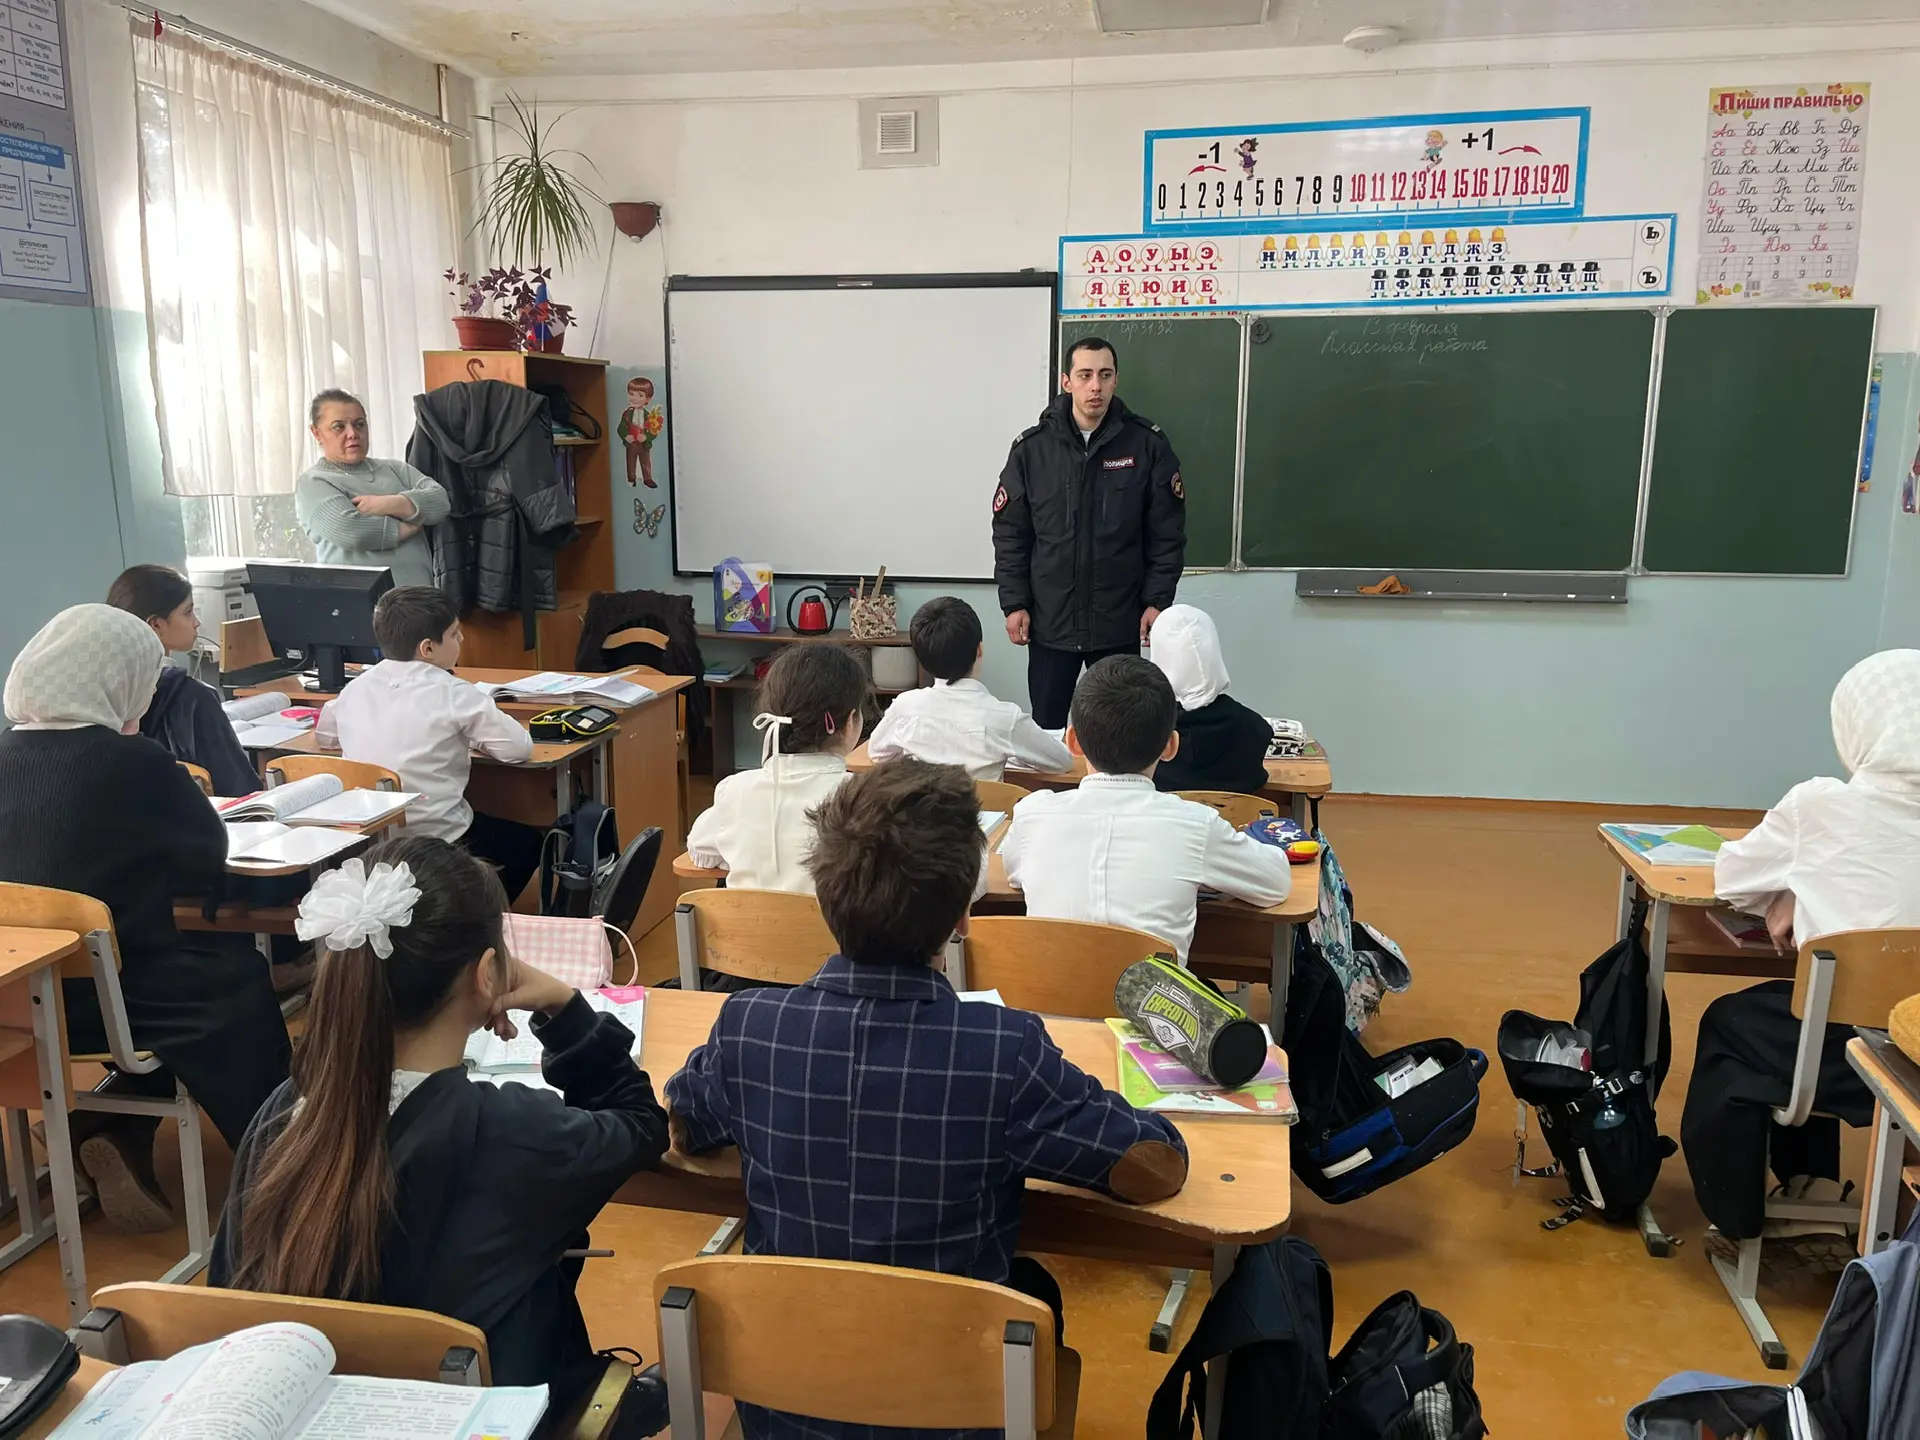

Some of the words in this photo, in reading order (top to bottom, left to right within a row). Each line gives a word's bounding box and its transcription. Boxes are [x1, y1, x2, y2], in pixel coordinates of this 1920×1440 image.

[1462, 128, 1494, 150] +1
[1198, 142, 1220, 164] -1
[1159, 184, 1166, 210] 0
[1180, 183, 1186, 209] 1
[1198, 182, 1206, 208] 2
[1216, 182, 1224, 208] 3
[1234, 181, 1242, 206] 4
[1256, 179, 1264, 206] 5
[1274, 178, 1282, 205] 6
[1296, 176, 1304, 204] 7
[1313, 176, 1322, 204] 8
[1333, 175, 1342, 203] 9
[1350, 174, 1365, 202] 10
[1370, 173, 1385, 201] 11
[1390, 172, 1407, 200] 12
[1410, 171, 1426, 200] 13
[1430, 170, 1446, 198] 14
[1452, 169, 1469, 198] 15
[1472, 168, 1488, 197] 16
[1493, 167, 1510, 196] 17
[1512, 166, 1529, 195] 18
[1531, 165, 1549, 194] 19
[1552, 164, 1569, 193] 20
[1092, 250, 1104, 262] А
[1119, 249, 1132, 261] О
[1146, 249, 1158, 261] У
[1171, 248, 1188, 260] Ы
[1201, 247, 1213, 259] Э
[1263, 252, 1275, 261] Н
[1285, 251, 1297, 260] М
[1308, 250, 1319, 260] Л
[1331, 249, 1340, 259] Р
[1376, 248, 1386, 258] Б
[1399, 247, 1409, 256] В
[1422, 246, 1431, 256] Г
[1445, 245, 1456, 255] Д
[1467, 244, 1480, 255] Ж
[1492, 244, 1502, 253] З
[1374, 280, 1385, 290] П
[1396, 280, 1409, 289] Ф
[1420, 279, 1430, 288] К
[1444, 278, 1453, 287] Т
[1465, 277, 1479, 287] Ш
[1491, 277, 1500, 286] С
[1514, 276, 1524, 285] Х
[1537, 275, 1549, 286] Ц
[1562, 274, 1571, 284] Ч
[1584, 273, 1597, 283] Щ
[1642, 272, 1656, 284] Ъ
[1091, 283, 1103, 295] Я
[1119, 280, 1130, 296] Ё
[1143, 281, 1160, 293] Ю
[1172, 281, 1186, 293] И
[1201, 280, 1213, 292] Е
[1320, 330, 1416, 355] Классная
[1419, 338, 1488, 364] работа
[1104, 459, 1132, 468] ПОЛИЦИЯ
[1144, 992, 1198, 1042] EXPEDITION
